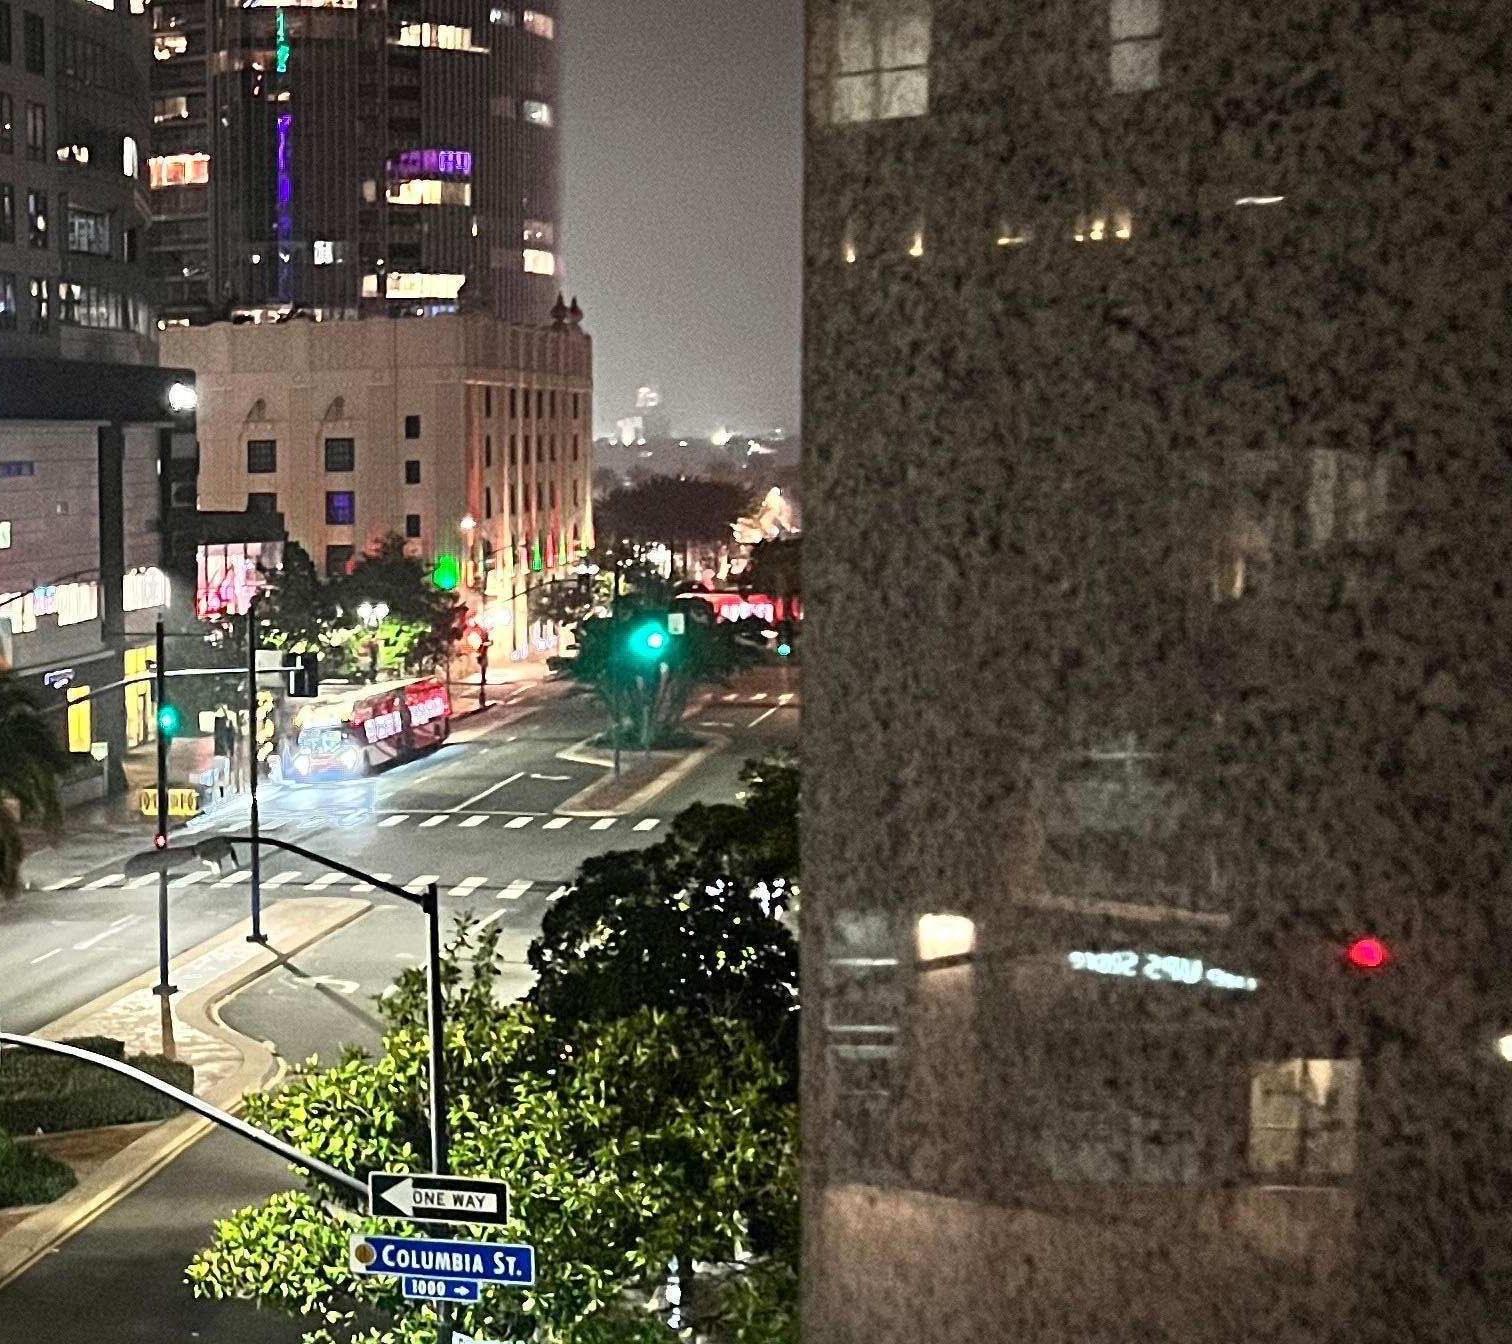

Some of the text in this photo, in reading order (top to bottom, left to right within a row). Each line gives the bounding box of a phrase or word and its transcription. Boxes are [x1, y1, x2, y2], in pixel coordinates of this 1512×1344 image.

[413, 1190, 487, 1209] ONE WAY
[381, 1244, 523, 1277] COLUMBIA ST.
[411, 1278, 446, 1297] 1000
